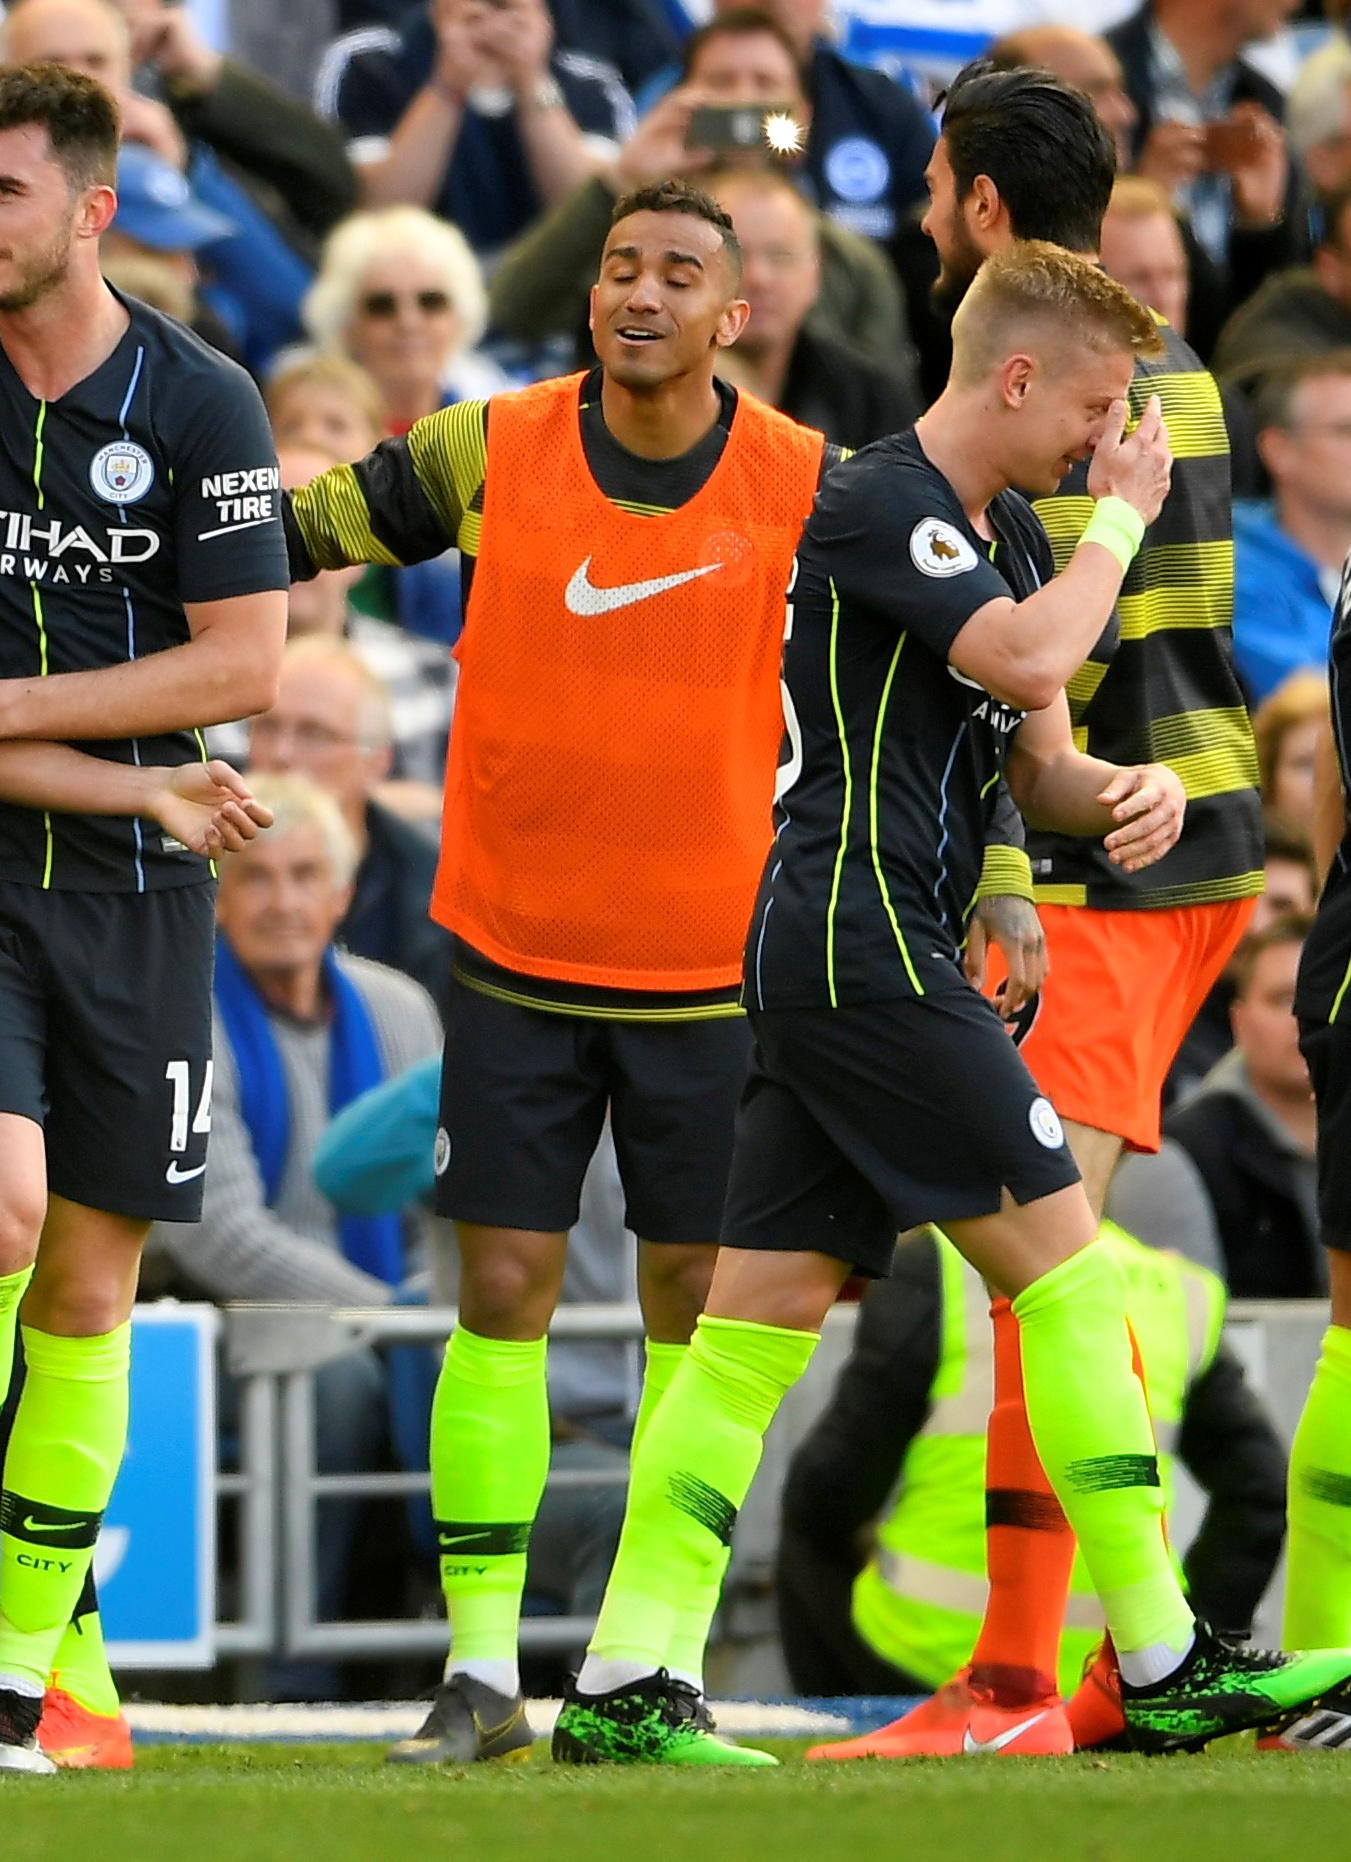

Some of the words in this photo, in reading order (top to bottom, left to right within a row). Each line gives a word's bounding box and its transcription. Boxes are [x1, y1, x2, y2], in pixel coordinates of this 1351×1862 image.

[98, 444, 148, 465] MANCHESTER
[201, 467, 279, 498] NEXEN
[109, 491, 127, 499] CITY
[215, 495, 273, 522] TIRE
[16, 1553, 73, 1573] CITY
